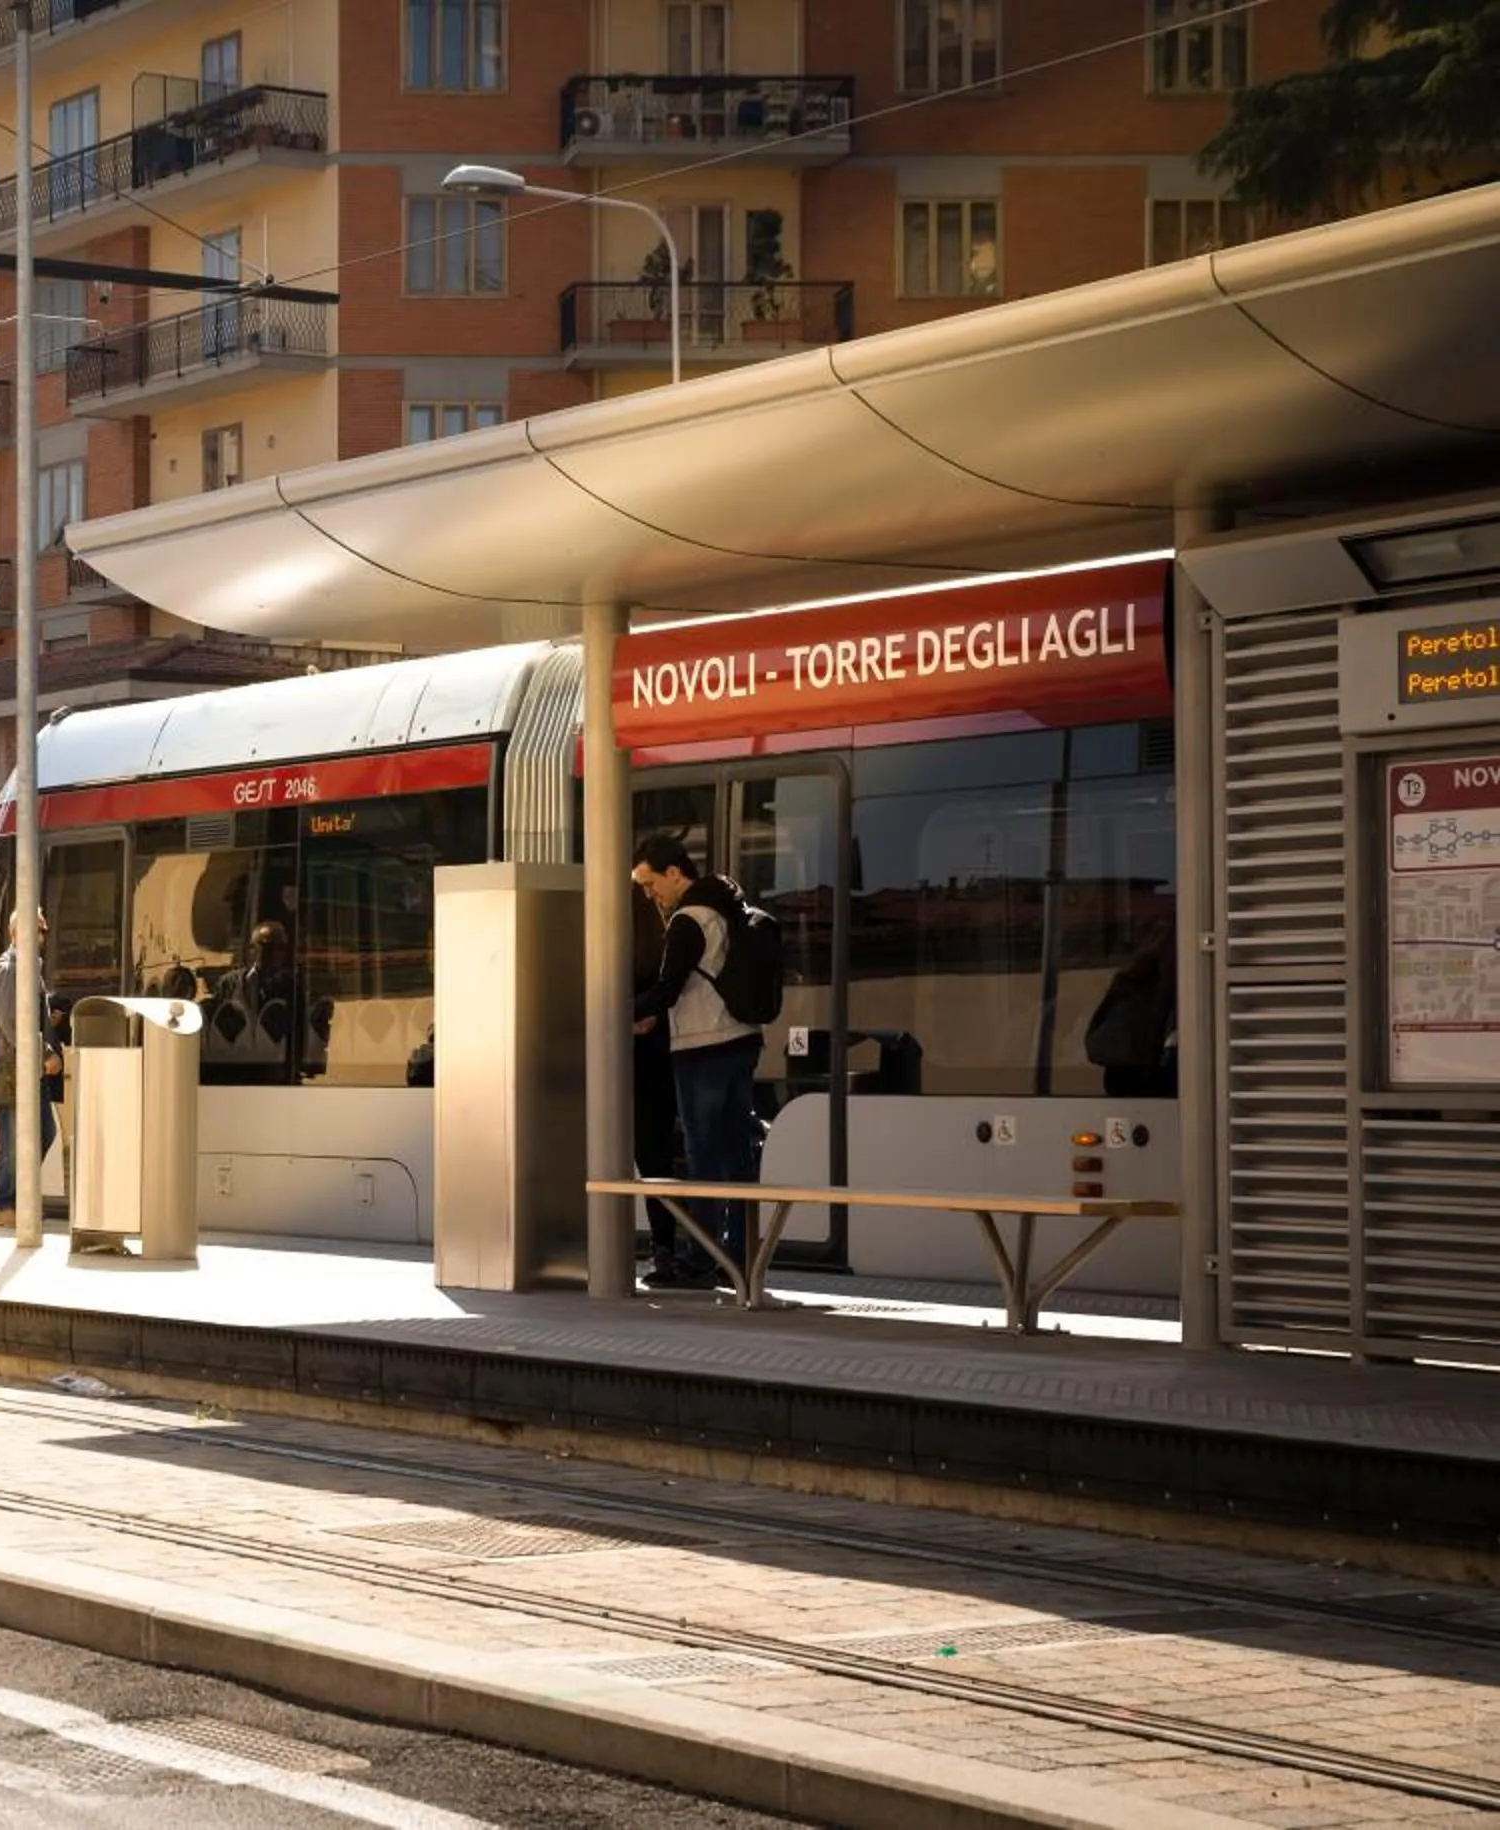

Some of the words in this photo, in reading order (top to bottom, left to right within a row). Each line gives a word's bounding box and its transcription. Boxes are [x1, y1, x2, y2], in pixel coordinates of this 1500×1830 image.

[633, 652, 756, 708] NOVOLI
[786, 633, 906, 691] TORRE
[917, 615, 1030, 677] DEGLI
[1039, 603, 1136, 662] AGLI
[1407, 626, 1499, 657] Peretol
[1408, 664, 1499, 696] Peretol
